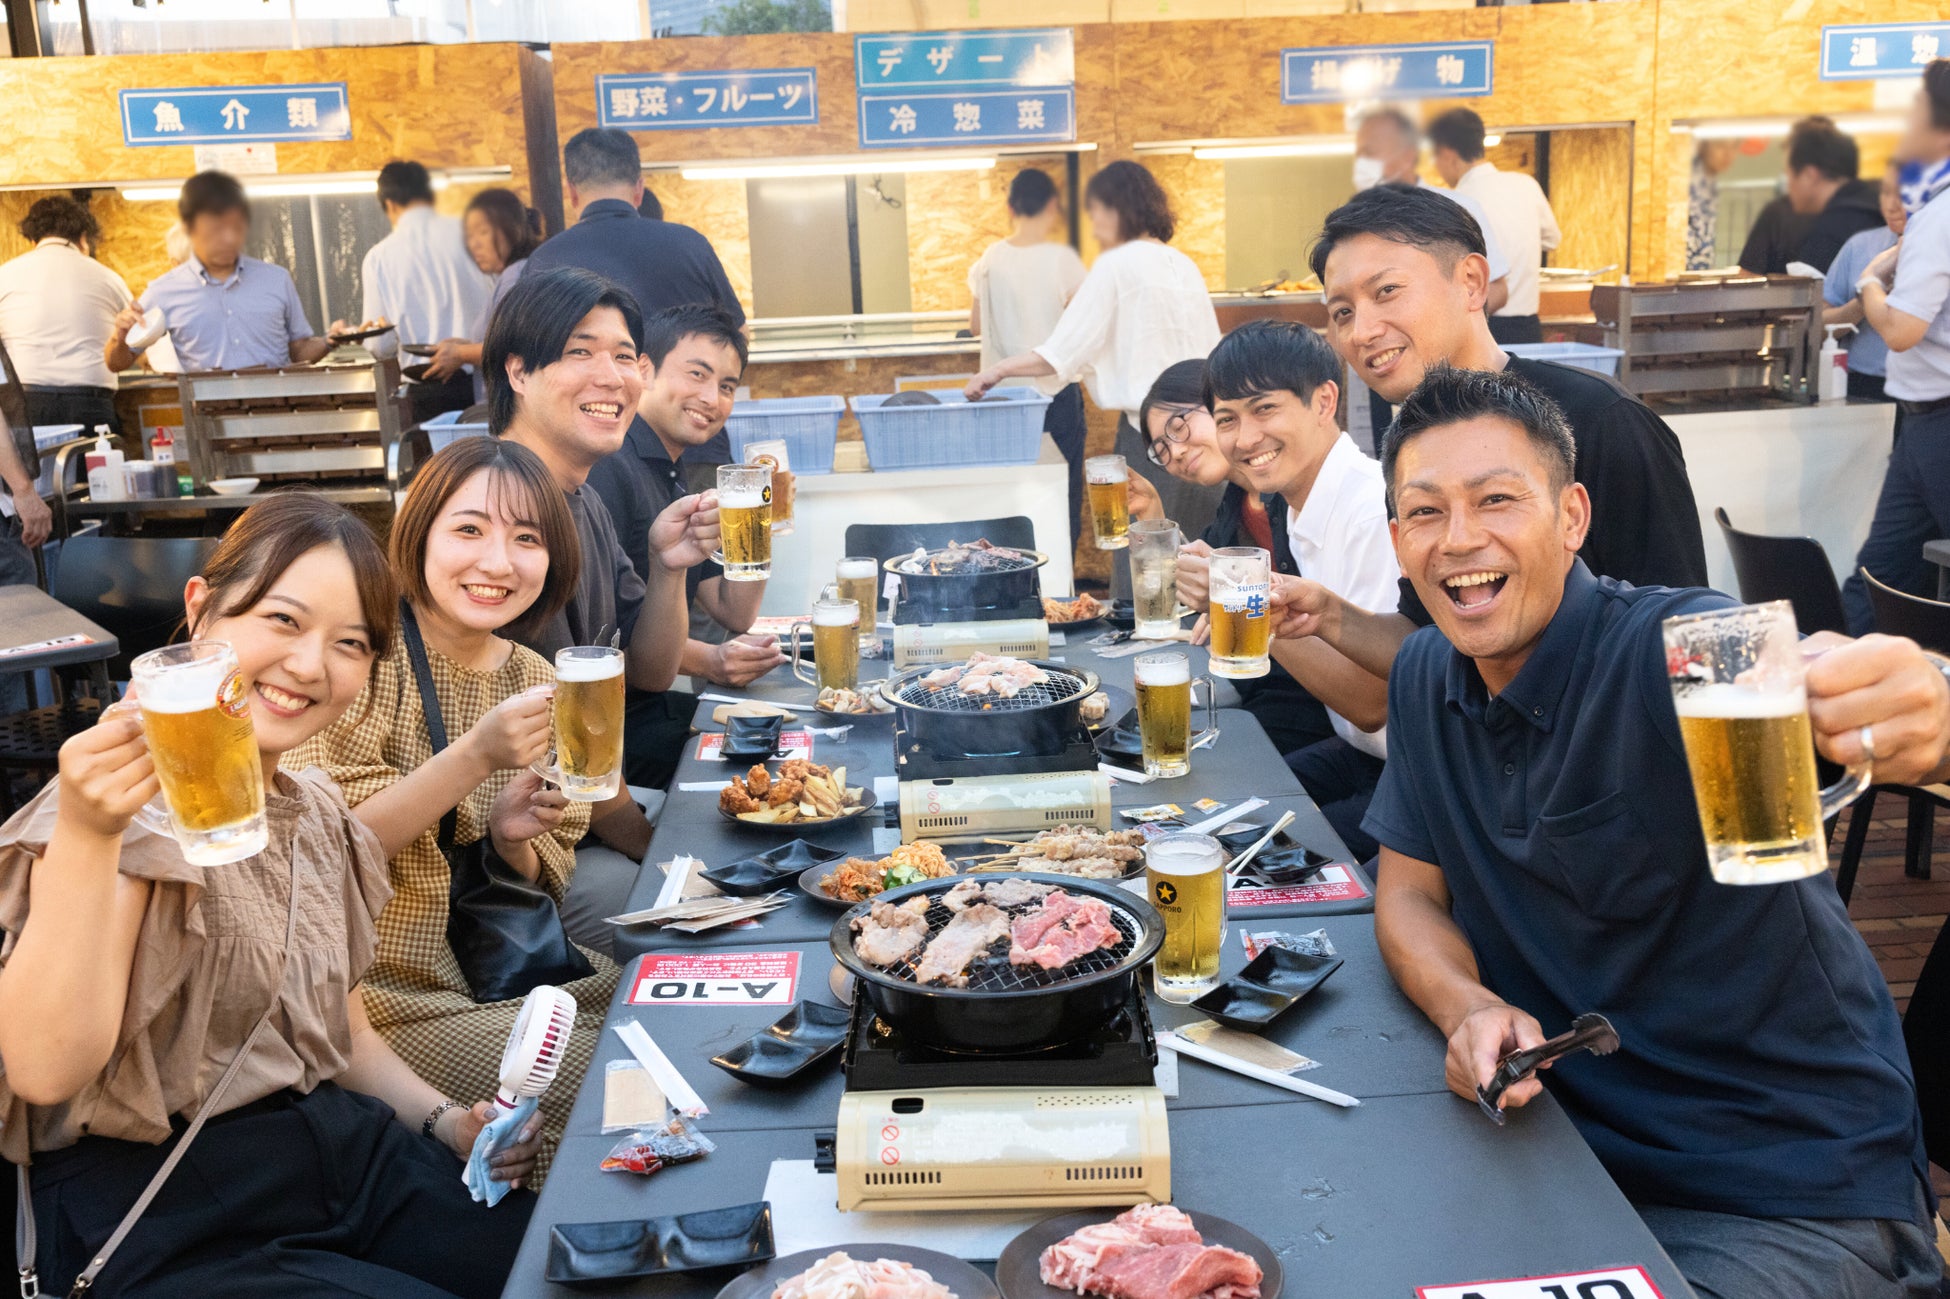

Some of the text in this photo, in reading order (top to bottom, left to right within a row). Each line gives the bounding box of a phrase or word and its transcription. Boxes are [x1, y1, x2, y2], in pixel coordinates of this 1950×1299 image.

[152, 97, 319, 133] 魚介類
[610, 84, 803, 117] 野菜・フルーツ
[888, 99, 1045, 134] 冷惣菜
[651, 982, 778, 998] A-10
